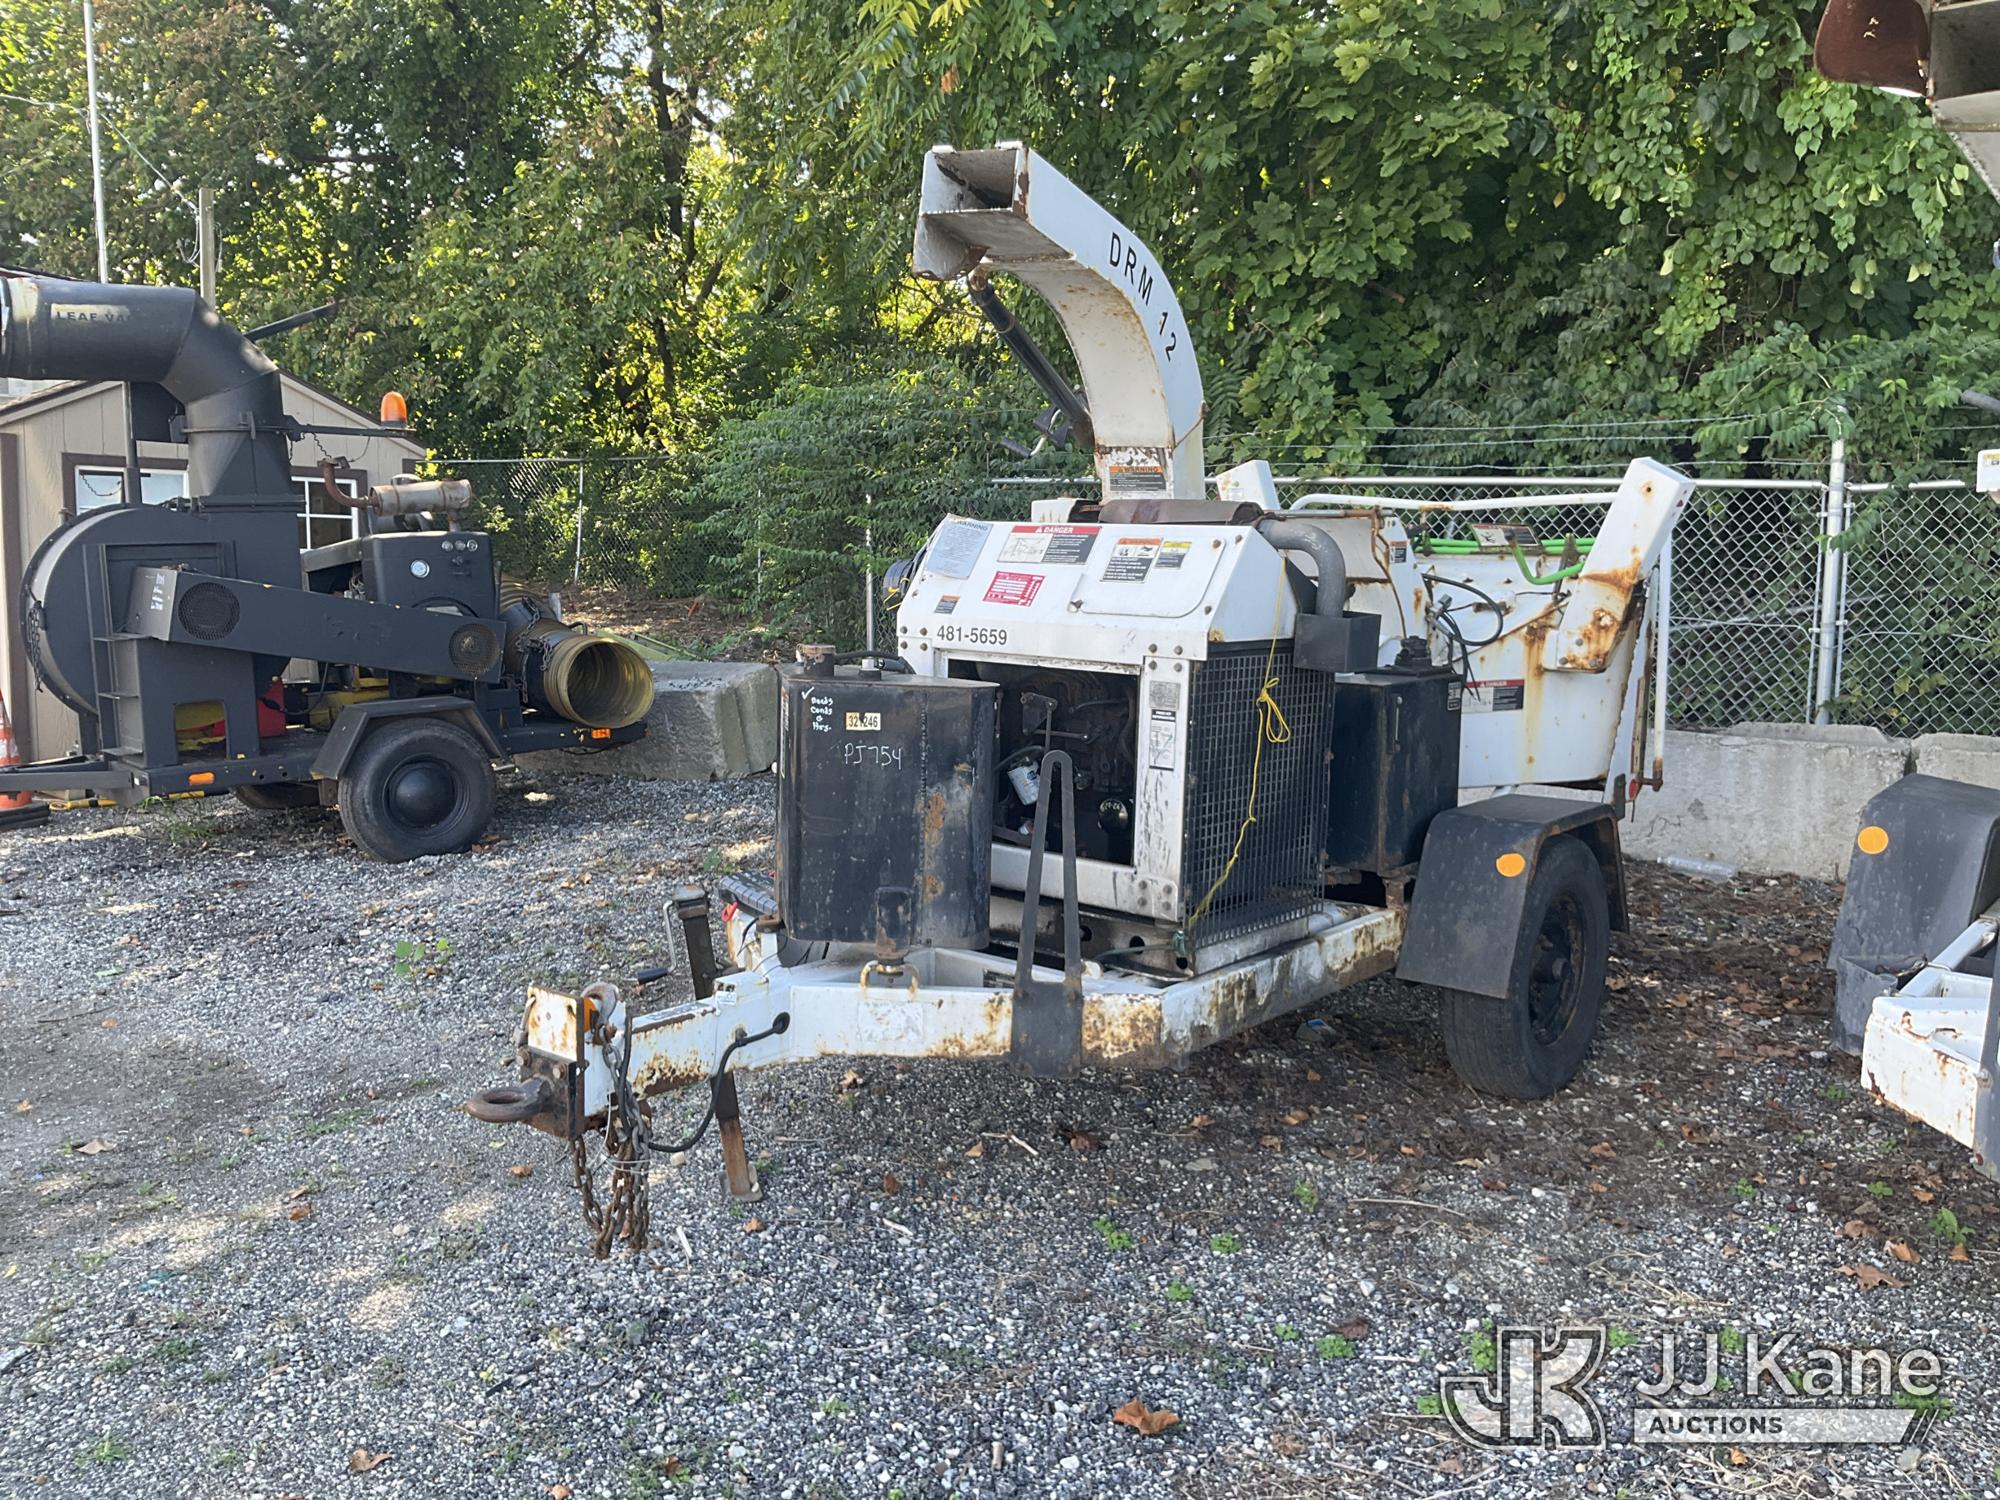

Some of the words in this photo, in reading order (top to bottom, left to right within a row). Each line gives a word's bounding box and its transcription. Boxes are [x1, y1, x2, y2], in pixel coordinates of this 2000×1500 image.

[1109, 232, 1154, 306] DRM
[1159, 311, 1177, 362] 12
[56, 311, 97, 322] LEAF
[1043, 526, 1074, 534] DANGER
[937, 625, 1008, 646] 481-5659
